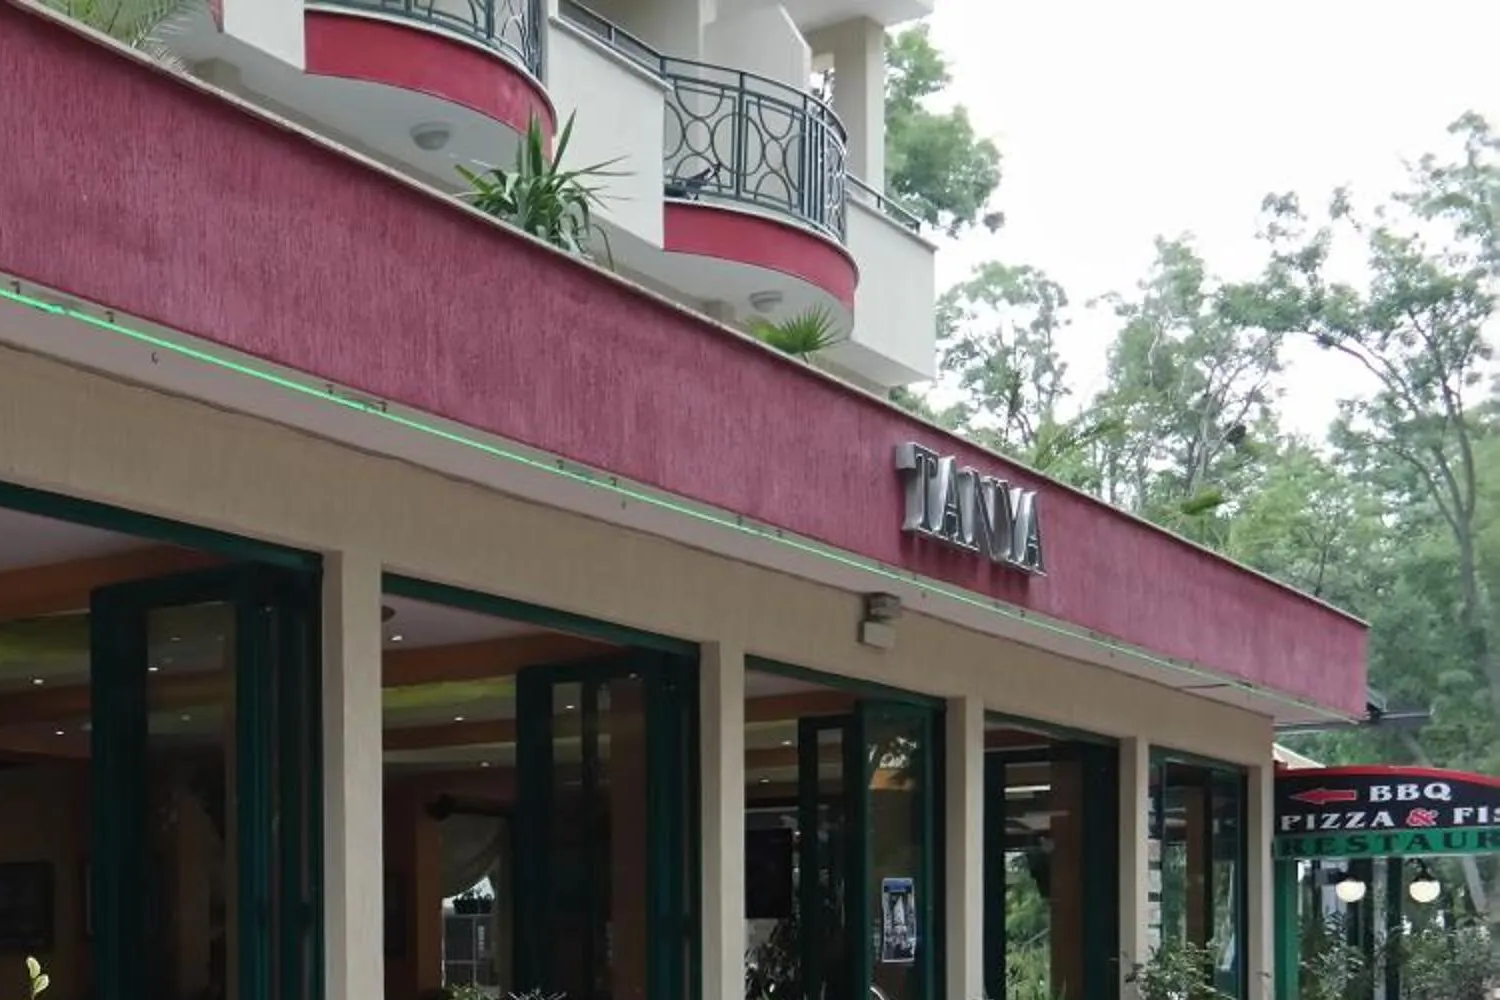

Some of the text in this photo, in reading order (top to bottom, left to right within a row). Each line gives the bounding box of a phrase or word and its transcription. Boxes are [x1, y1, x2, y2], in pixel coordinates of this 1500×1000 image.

[896, 441, 1047, 576] TANYA
[1369, 782, 1453, 802] BBQ
[1281, 811, 1395, 831] PIZZA
[1406, 808, 1439, 827] &
